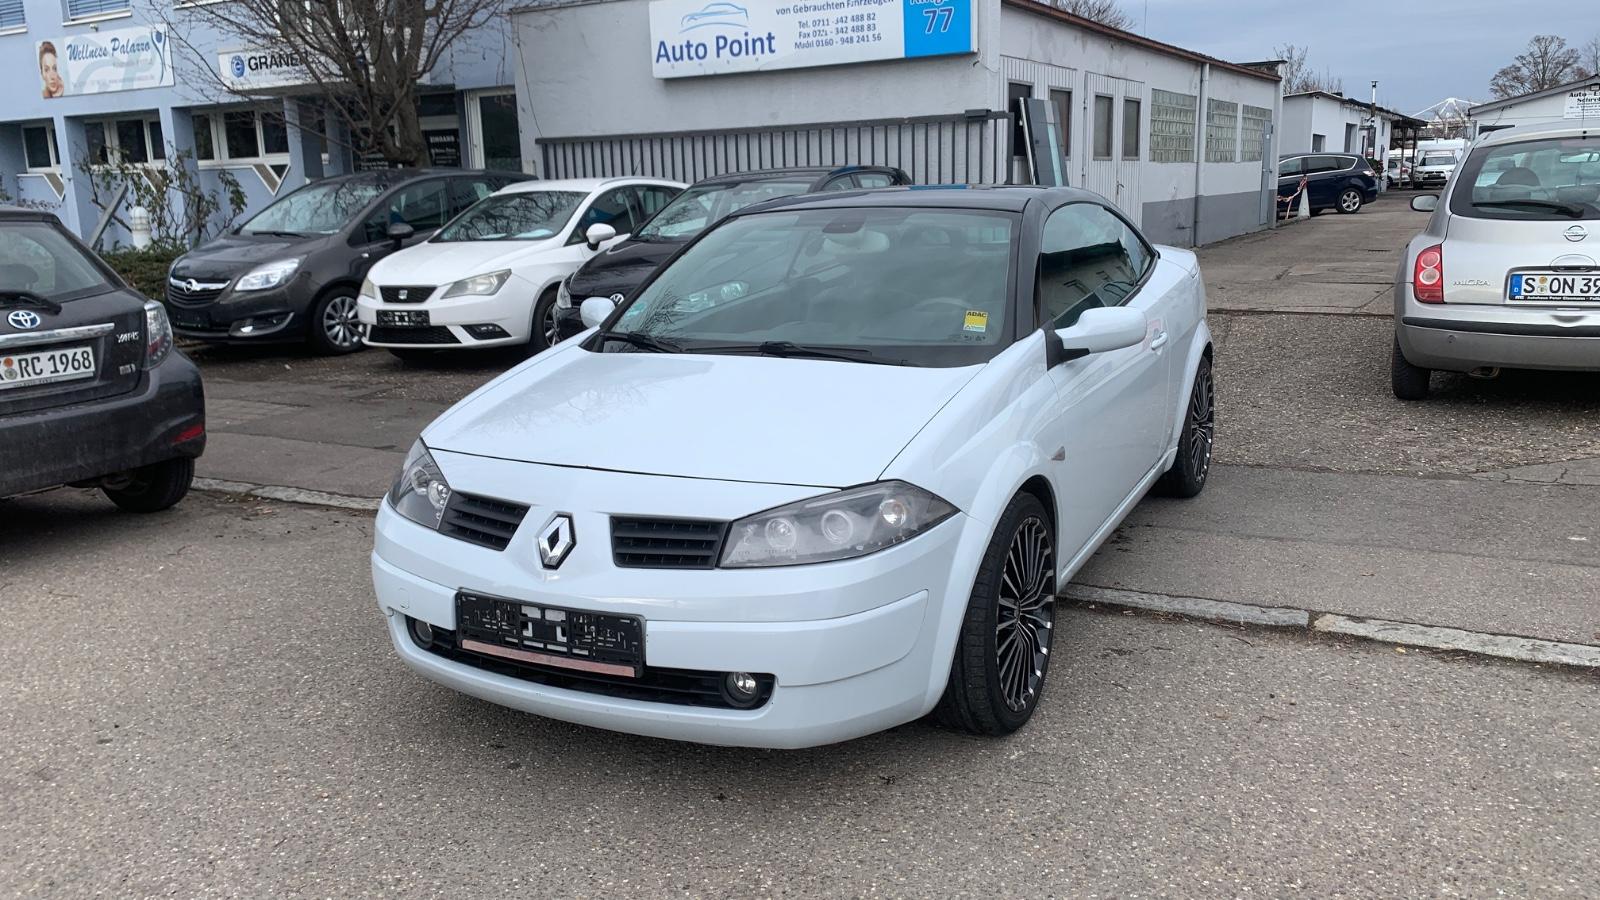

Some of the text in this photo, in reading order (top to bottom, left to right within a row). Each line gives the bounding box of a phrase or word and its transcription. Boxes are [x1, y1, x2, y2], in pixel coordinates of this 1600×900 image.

[776, 0, 894, 15] von Gebrauchten Fahrzeug
[798, 20, 811, 29] Tel.
[812, 18, 830, 27] 0711
[851, 13, 865, 22] 488
[866, 12, 876, 21] 82
[922, 7, 954, 34] 77
[799, 31, 811, 39] Fax
[835, 26, 849, 35] 342
[851, 24, 865, 33] 488
[866, 23, 877, 32] 83
[655, 31, 776, 63] Auto Point
[815, 38, 834, 47] 0160
[840, 36, 854, 45] 948
[856, 34, 870, 43] 241
[872, 33, 882, 42] 56
[66, 37, 151, 61] Wellness Palazzo
[248, 53, 304, 71] GRANE
[1523, 277, 1536, 293] S
[1549, 277, 1576, 294] ON
[17, 356, 43, 378] RC
[47, 350, 92, 374] 1968
